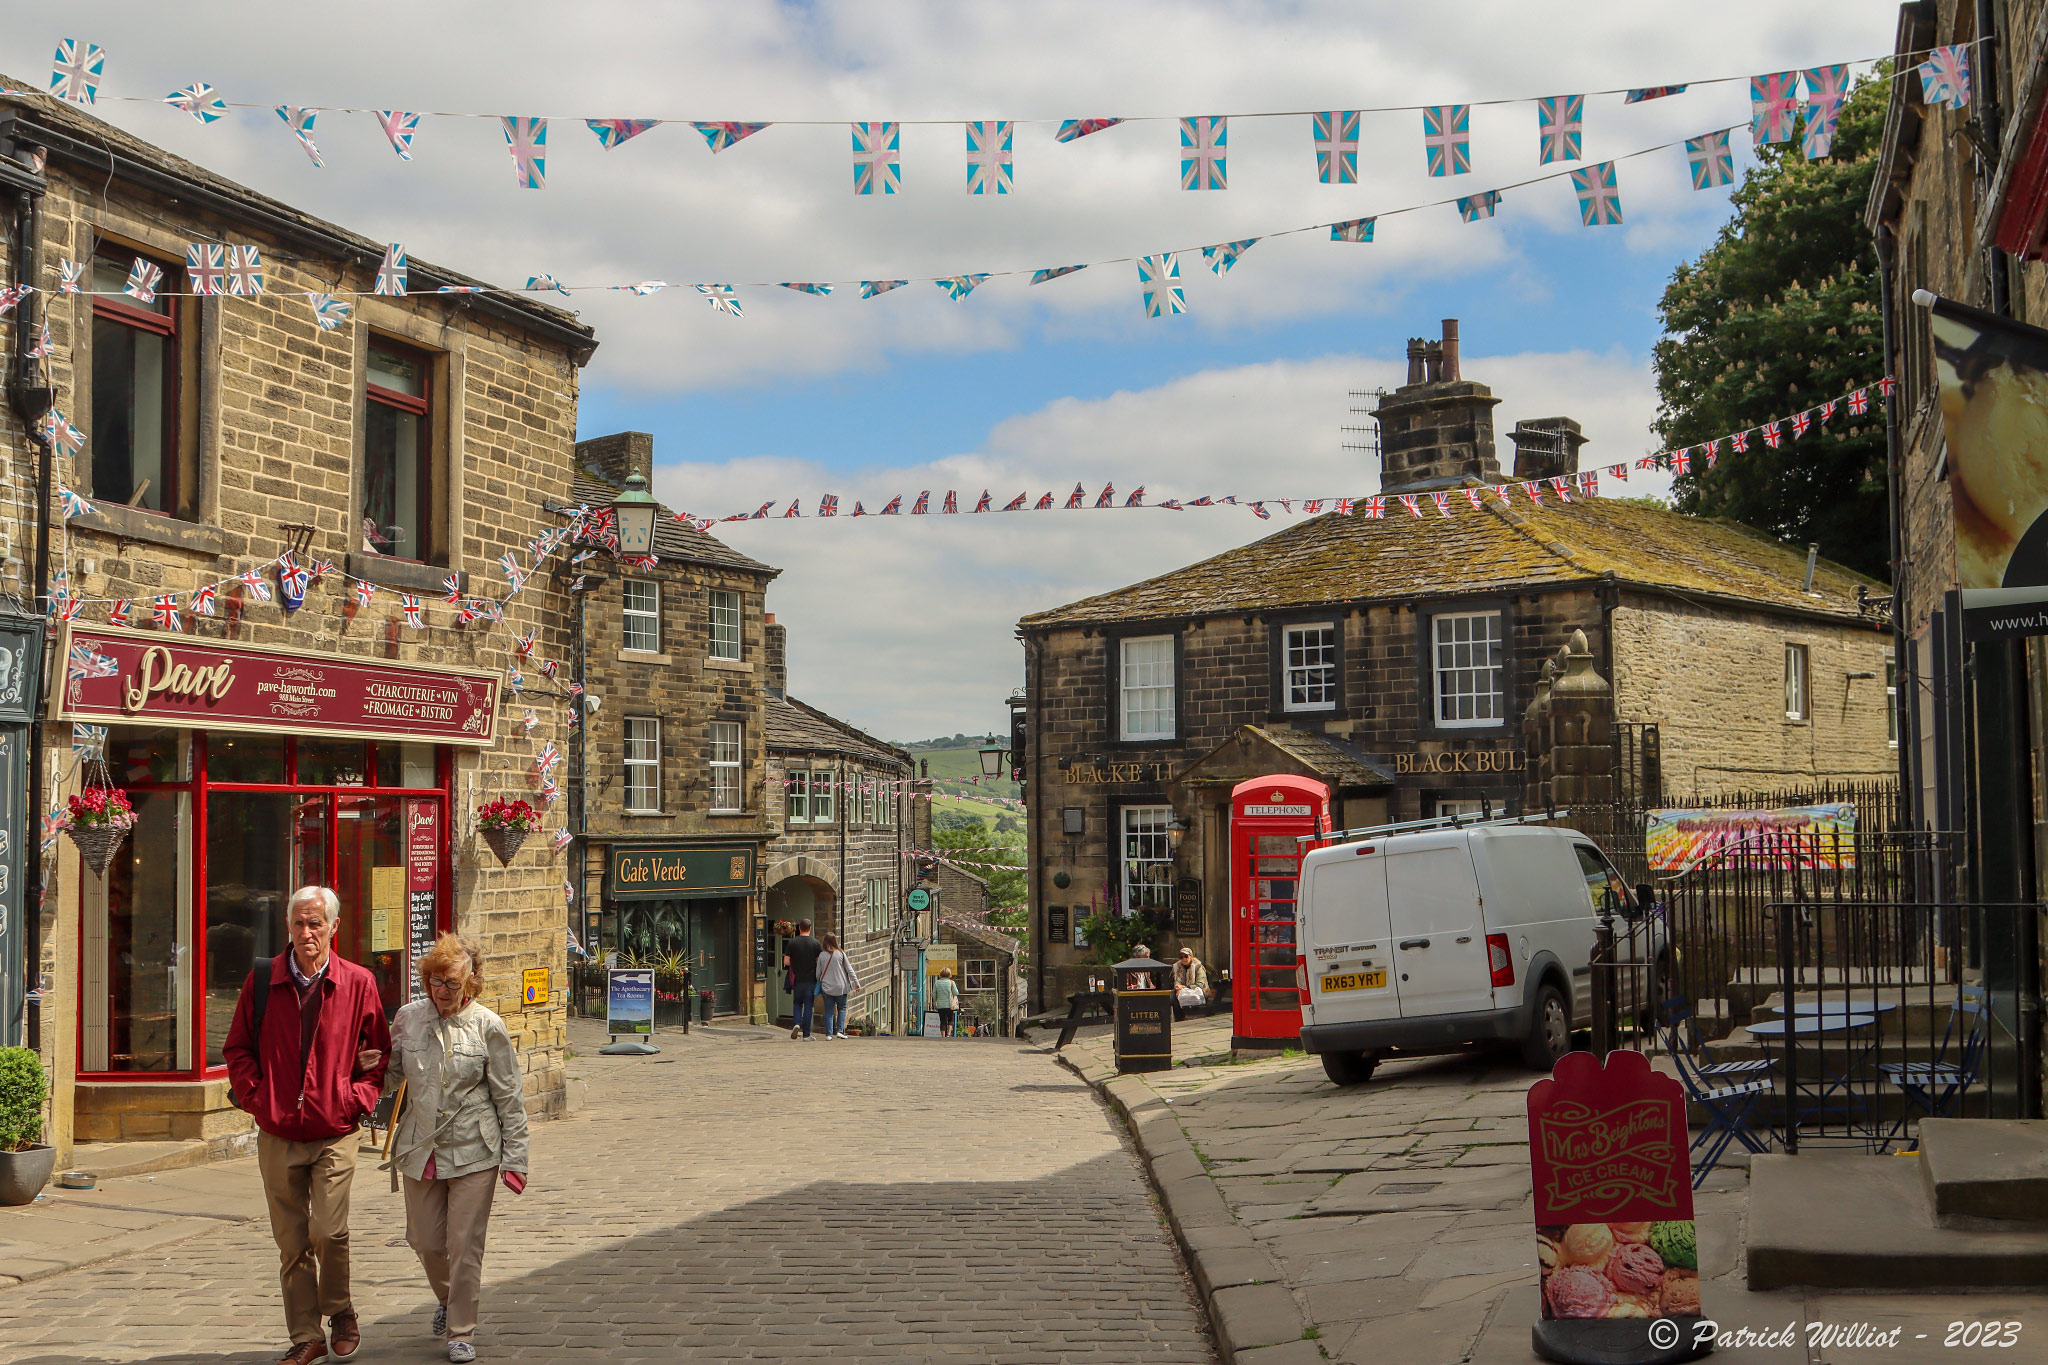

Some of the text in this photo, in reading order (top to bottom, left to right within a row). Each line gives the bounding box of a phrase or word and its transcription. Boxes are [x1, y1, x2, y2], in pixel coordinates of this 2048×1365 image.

[126, 645, 236, 711] Pavé
[257, 680, 336, 698] pave-haworth.com
[370, 683, 459, 704] CHARCUTERIE VIN
[289, 694, 302, 703] Main
[302, 695, 315, 704] Street
[368, 701, 453, 720] FROMAGE BISTRO
[1395, 751, 1472, 774] BLACK
[1065, 764, 1126, 784] BLACK
[1249, 806, 1306, 815] TELEPHONE
[1677, 817, 1730, 833] HAWORTH
[620, 857, 687, 883] Cafe Verde
[1313, 946, 1349, 956] TRANSIT
[1325, 973, 1381, 990] RX63 YRT
[1130, 1011, 1160, 1019] LITTER
[1547, 1107, 1667, 1161] Mrs Beightons
[1567, 1163, 1656, 1188] ICE CREAM
